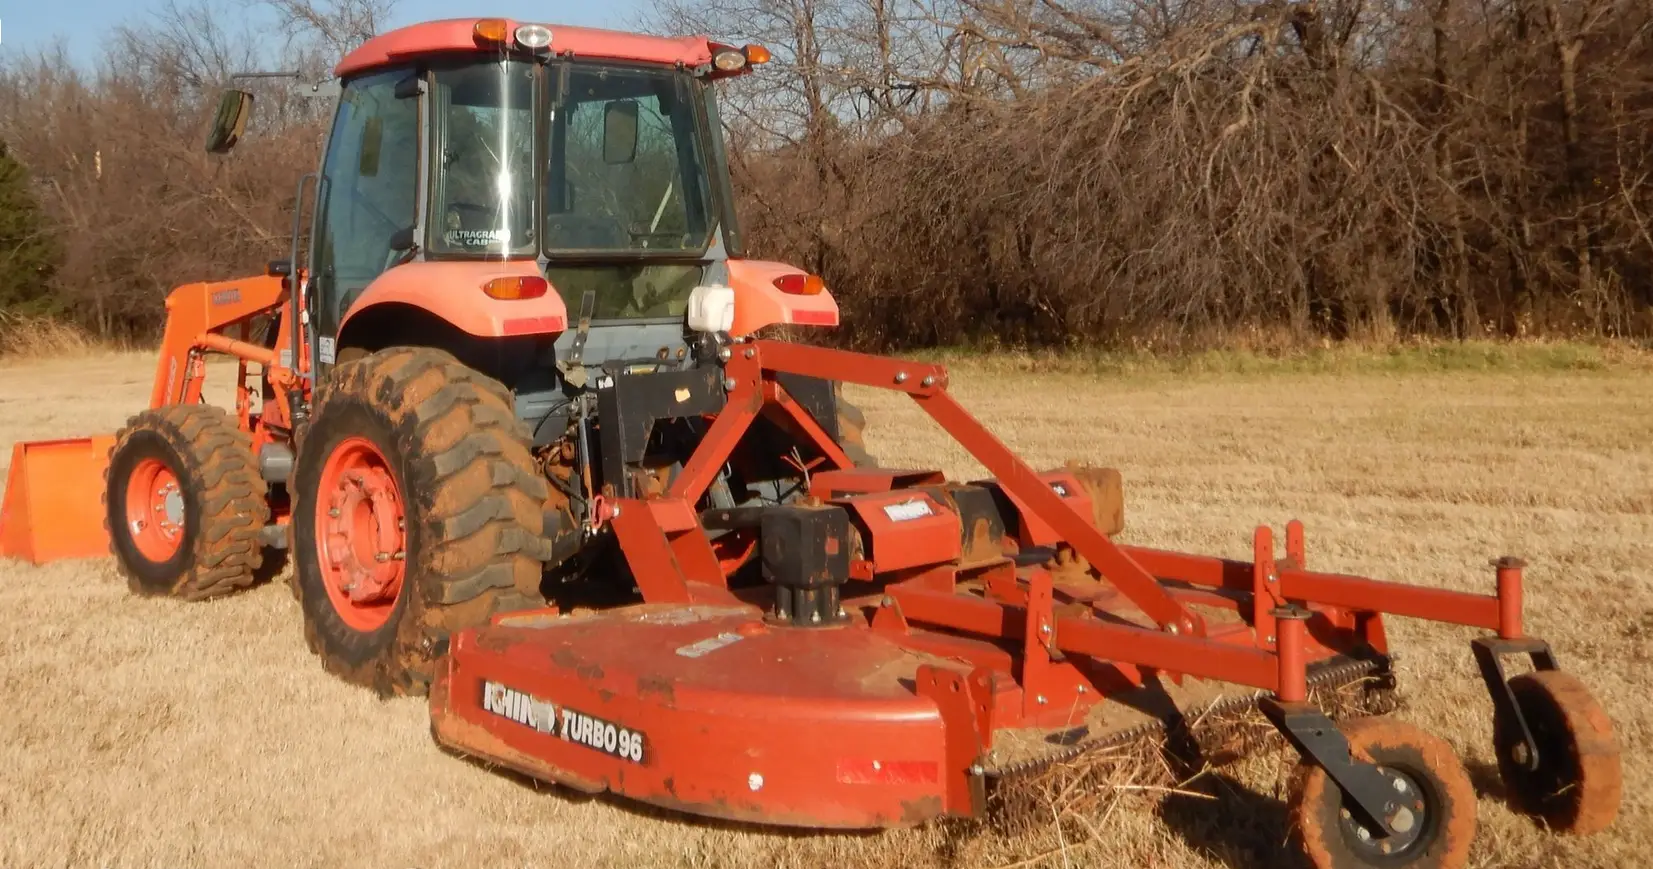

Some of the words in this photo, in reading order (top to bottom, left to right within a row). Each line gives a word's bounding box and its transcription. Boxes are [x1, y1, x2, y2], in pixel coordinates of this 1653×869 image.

[449, 229, 511, 241] ULTRAGRA
[561, 708, 617, 752] TURBO
[618, 728, 643, 761] 96
